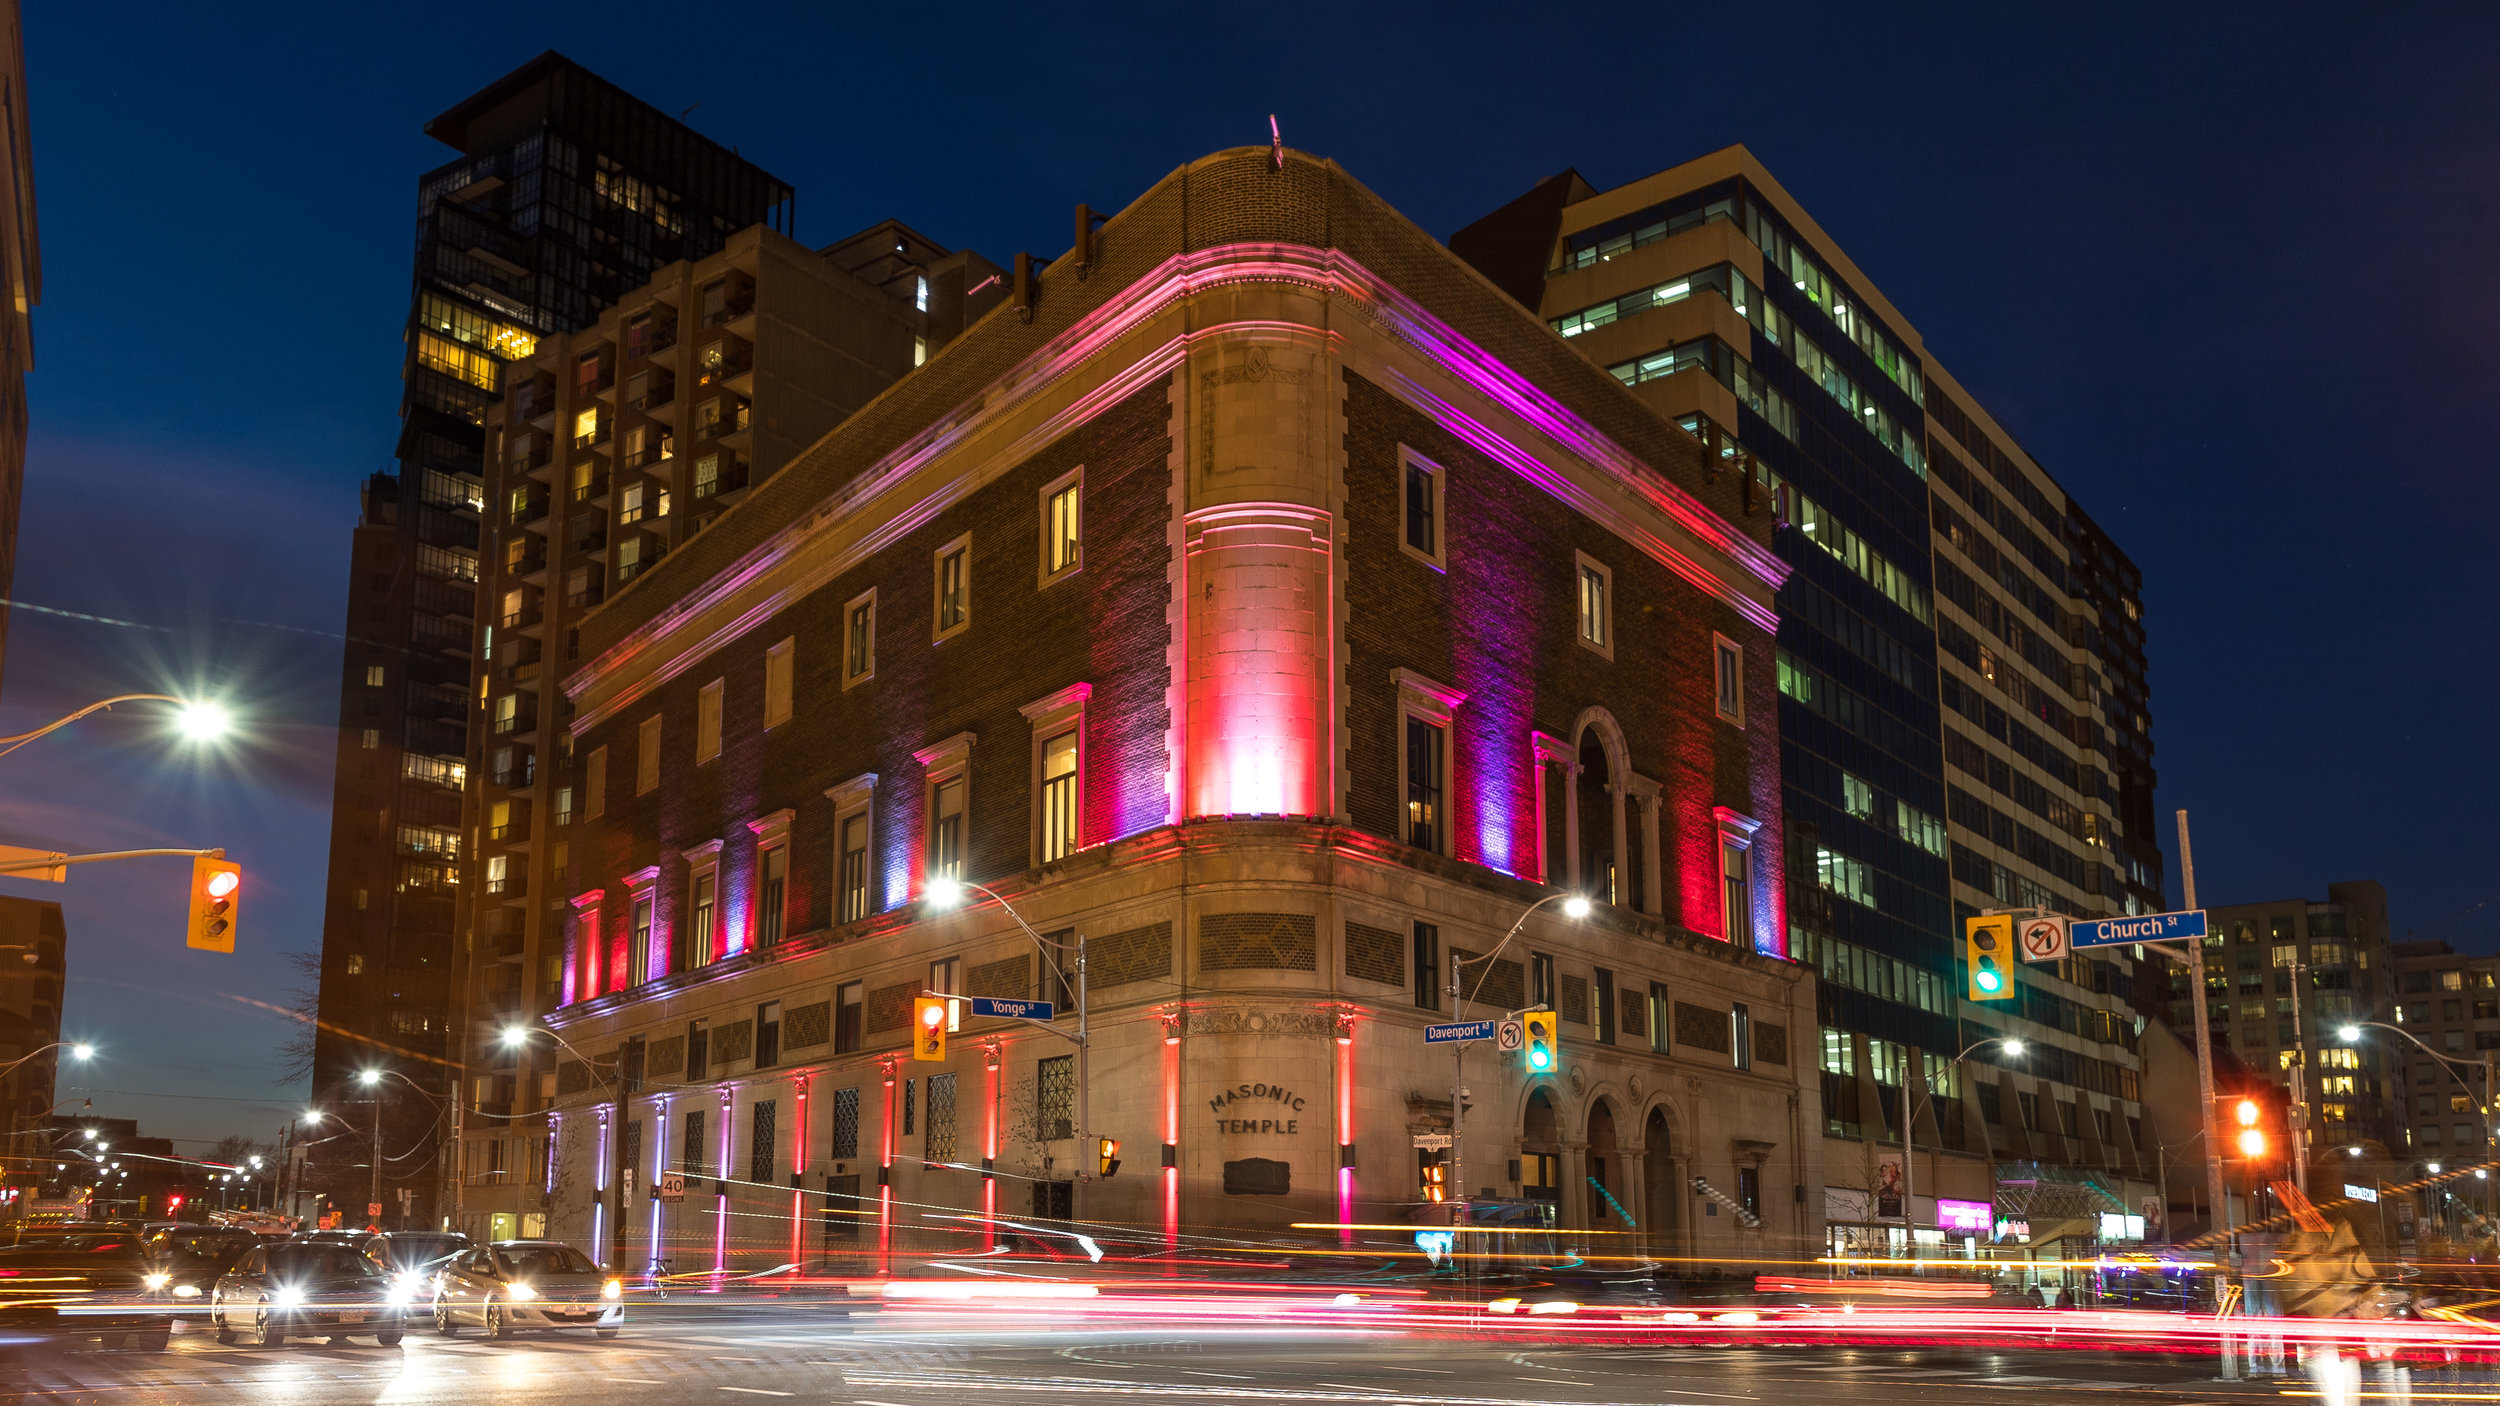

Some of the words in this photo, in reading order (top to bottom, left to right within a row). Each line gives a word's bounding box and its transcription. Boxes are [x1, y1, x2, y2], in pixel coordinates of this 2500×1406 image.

[2097, 918, 2163, 939] Church
[2167, 916, 2178, 926] St
[991, 1000, 1026, 1017] Yonge
[1429, 1023, 1480, 1039] Davenport
[1209, 1083, 1306, 1113] MASONIC
[1216, 1119, 1298, 1134] TEMPLE
[1414, 1137, 1443, 1146] Davenport
[1444, 1137, 1452, 1145] Rd
[665, 1180, 682, 1192] 40
